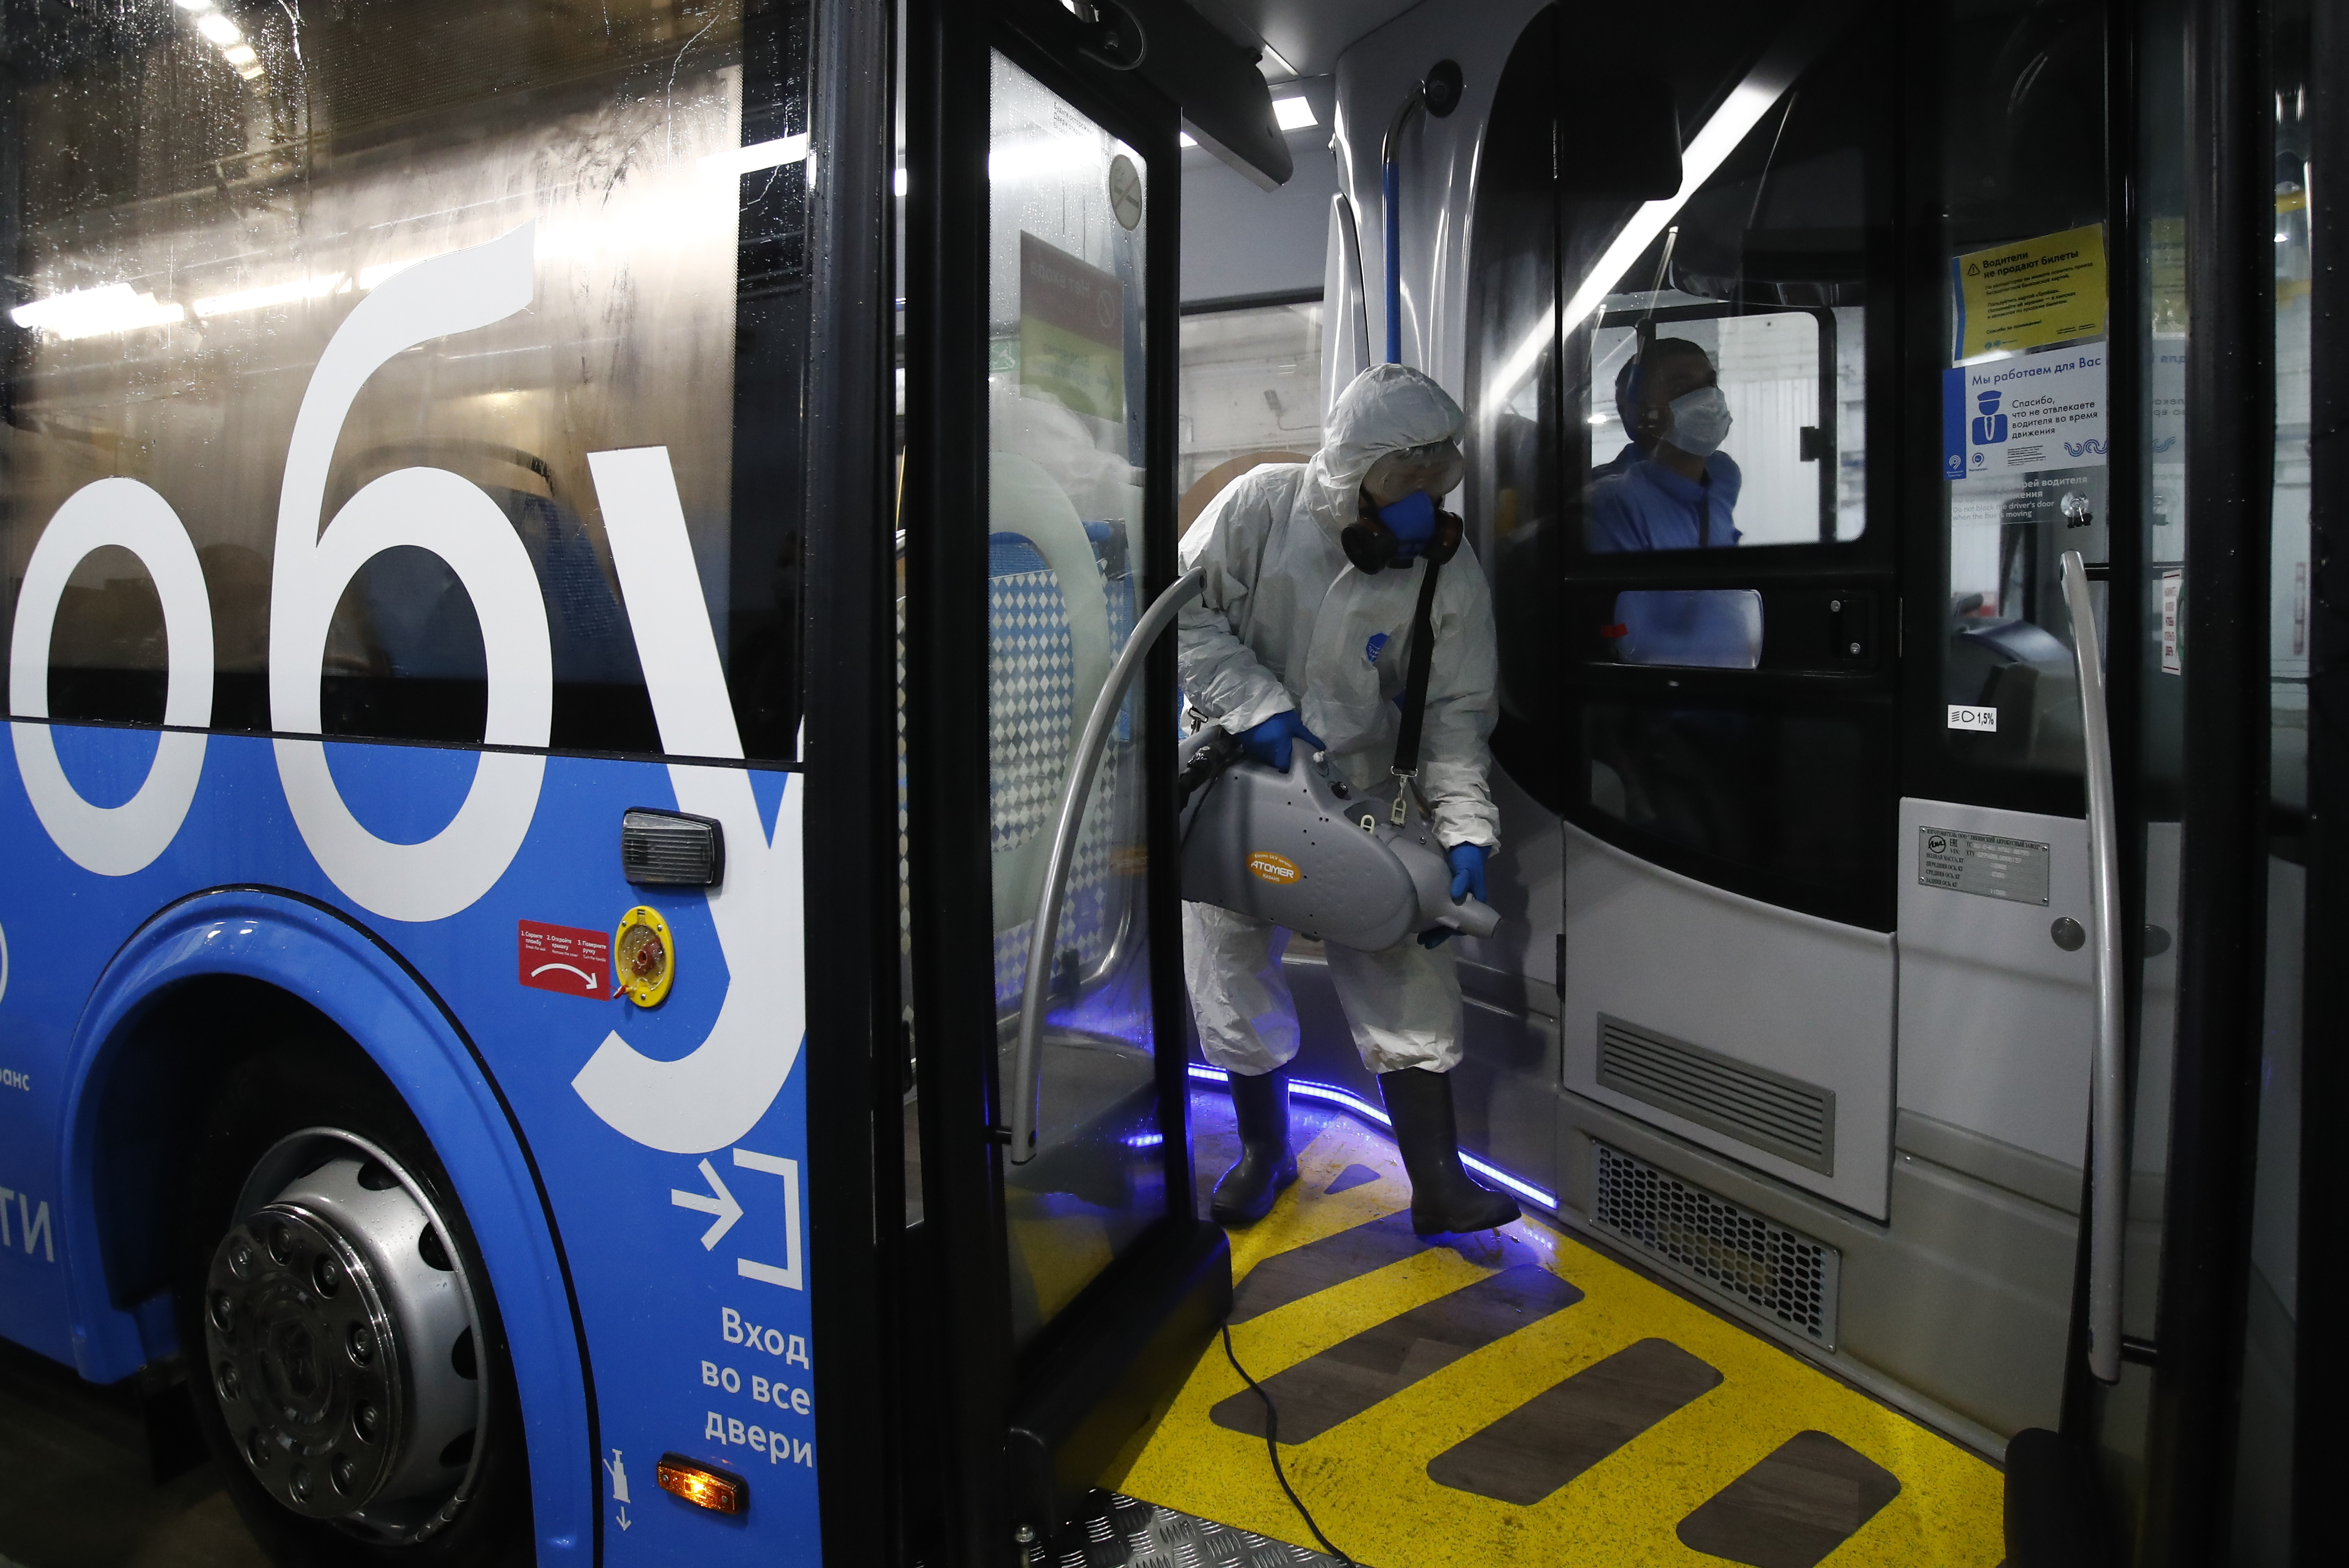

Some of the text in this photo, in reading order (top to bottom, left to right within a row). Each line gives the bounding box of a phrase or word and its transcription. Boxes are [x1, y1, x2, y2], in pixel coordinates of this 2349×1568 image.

[1053, 112, 1068, 128] Двери
[1983, 251, 2028, 268] Водители
[1984, 251, 2078, 279] не продают билеты
[1972, 357, 2101, 386] Мы работаем для Вас
[2012, 395, 2055, 409] Спасибо,
[2012, 410, 2027, 419] что
[2043, 401, 2095, 415] отвлекаете
[2012, 417, 2052, 429] водителя
[2069, 411, 2097, 423] время
[2012, 427, 2055, 439] движения
[2042, 476, 2088, 487] водителя
[2009, 501, 2035, 509] driver's
[2006, 510, 2033, 519] moving
[1977, 712, 1994, 726] 1,5%
[1251, 860, 1294, 878] ATOMER
[551, 936, 572, 944] Откройте
[582, 941, 607, 949] Поверните
[722, 1306, 809, 1370] Вход
[701, 1360, 811, 1415] во все
[705, 1411, 813, 1468] двери
